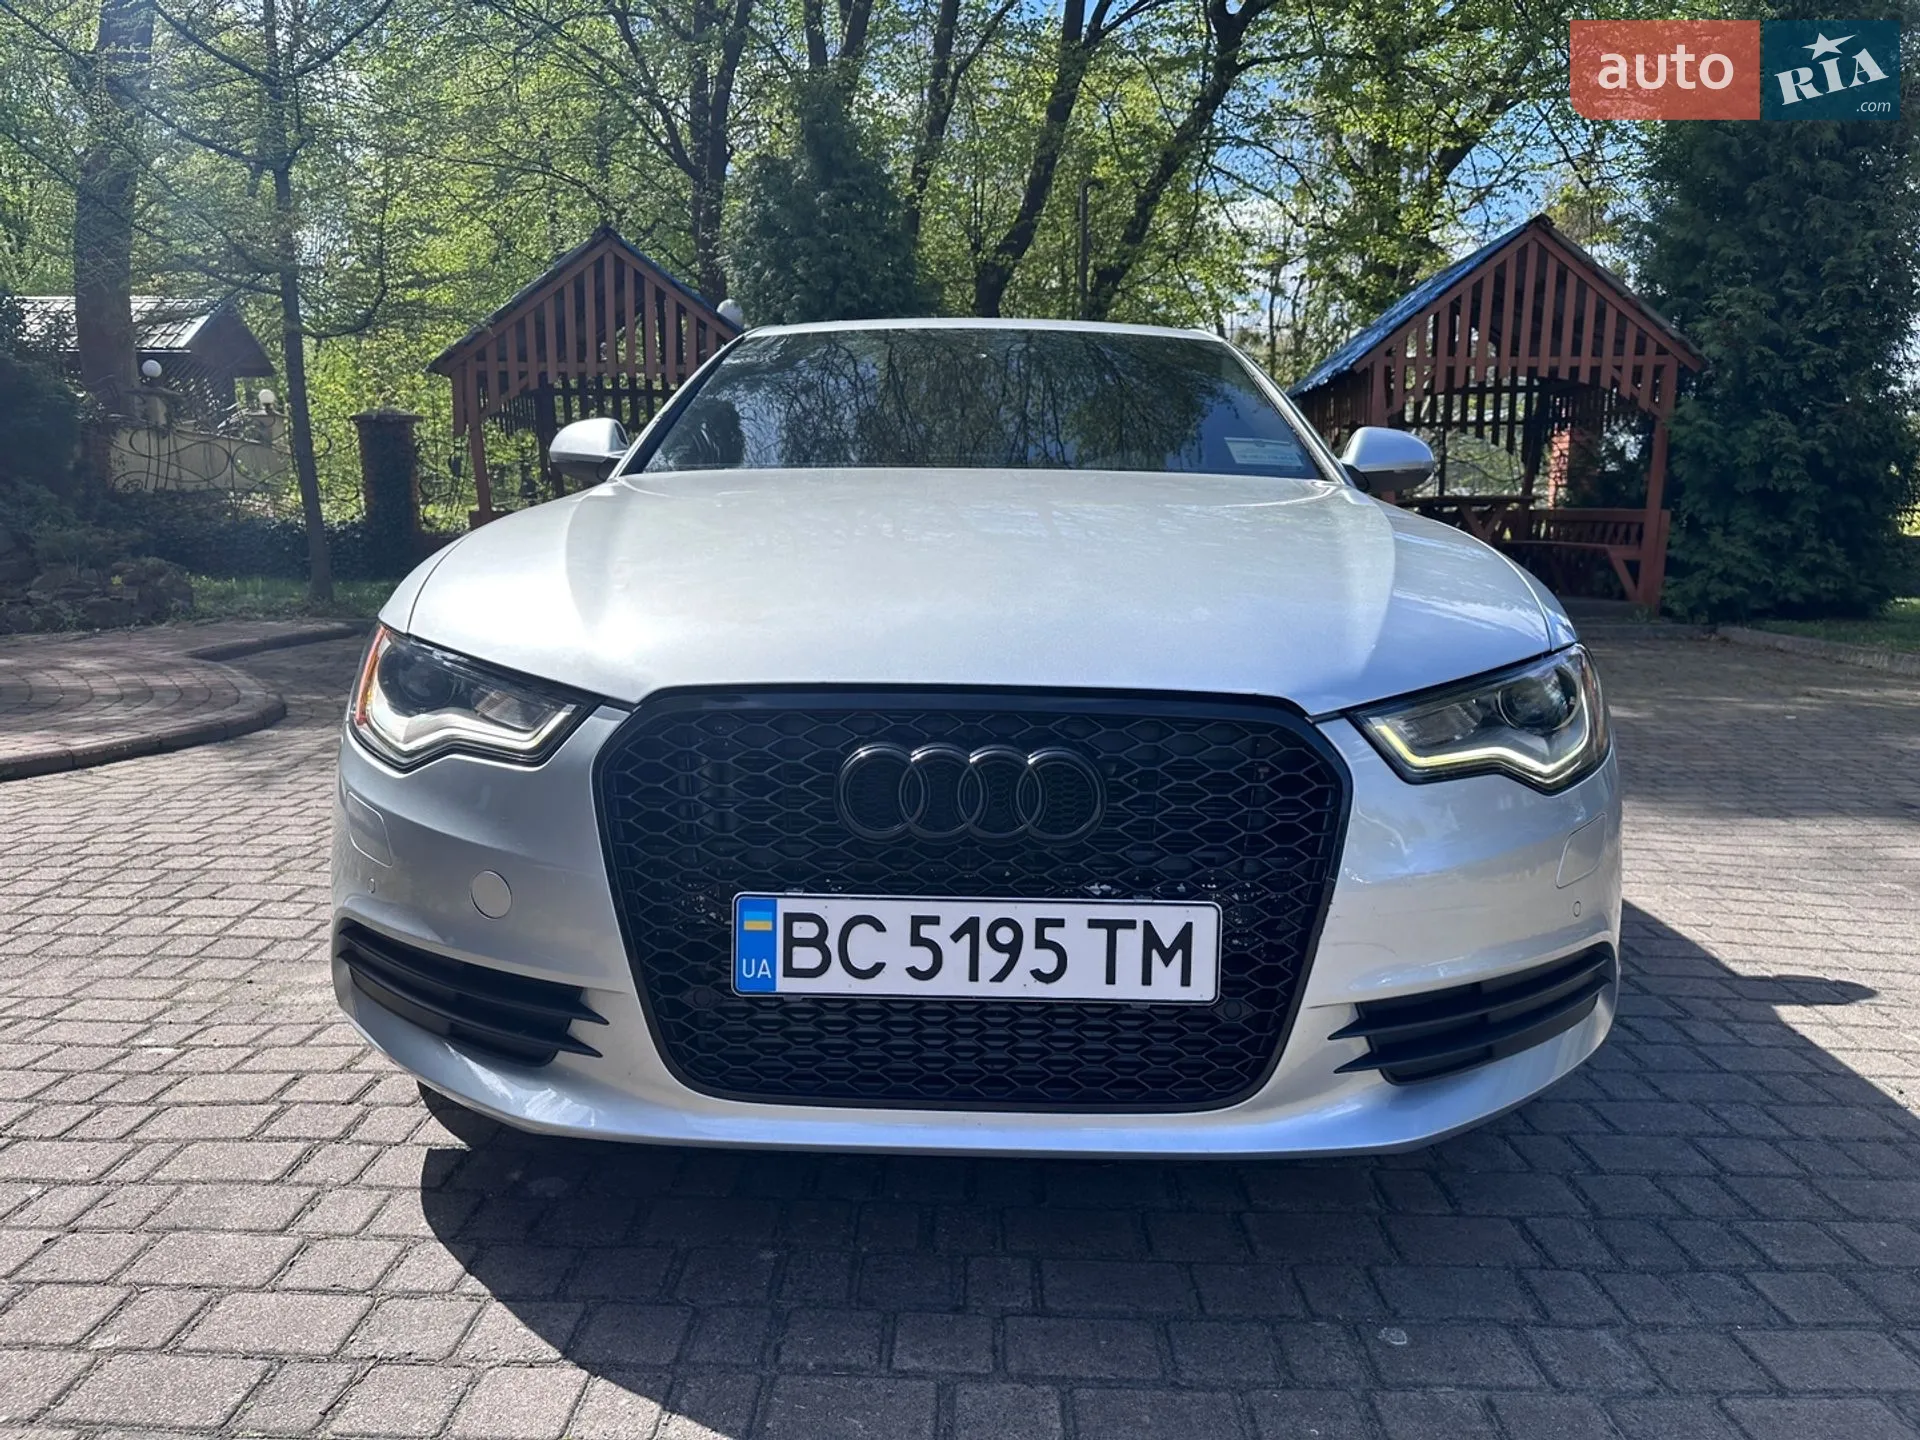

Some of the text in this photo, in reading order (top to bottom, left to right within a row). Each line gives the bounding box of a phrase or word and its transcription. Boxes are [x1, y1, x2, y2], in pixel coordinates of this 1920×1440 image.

[741, 958, 773, 980] UA
[782, 911, 1194, 987] BC 5195 TM
